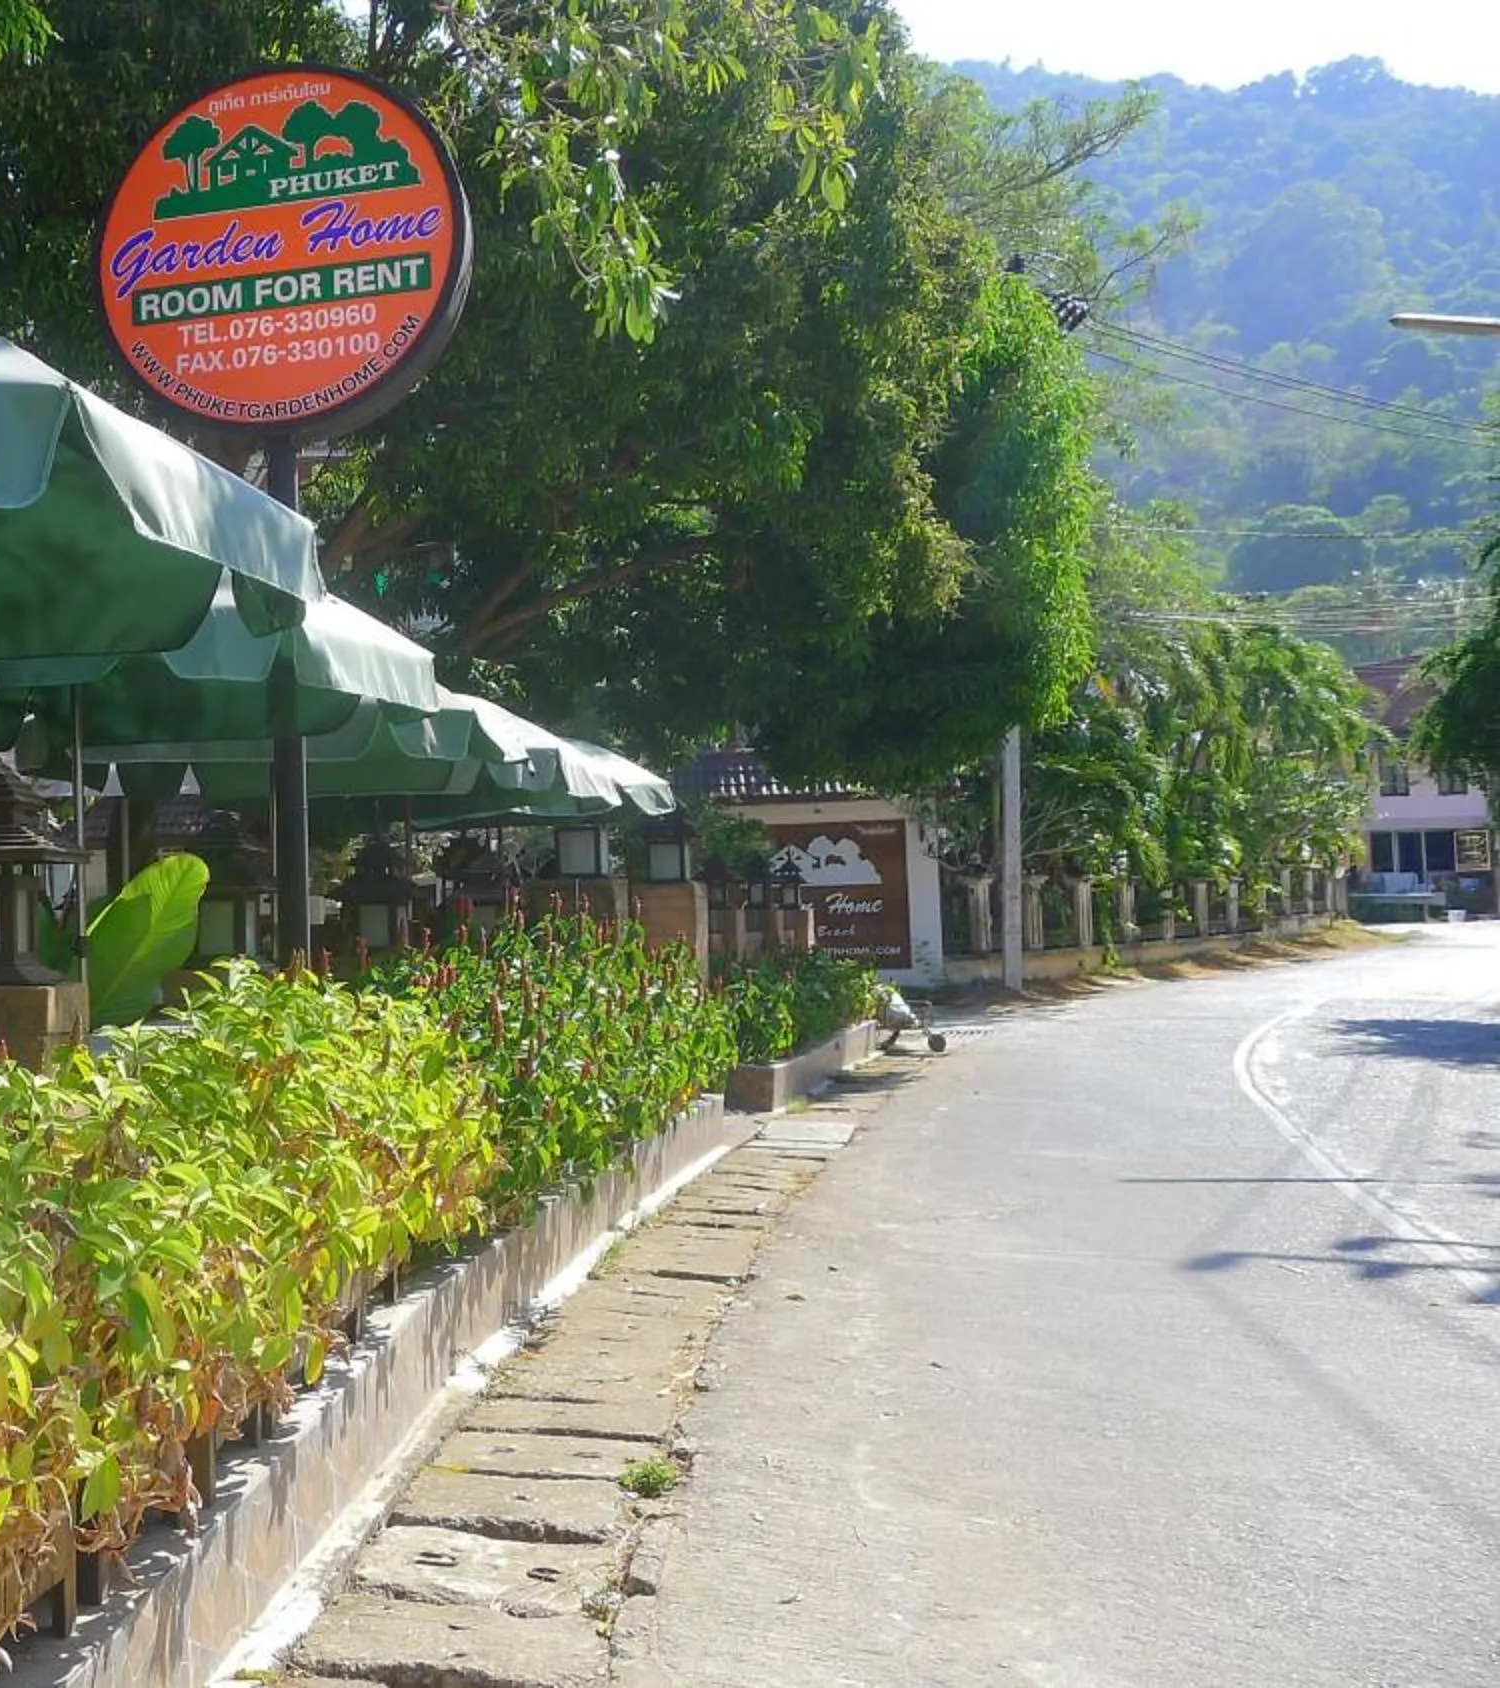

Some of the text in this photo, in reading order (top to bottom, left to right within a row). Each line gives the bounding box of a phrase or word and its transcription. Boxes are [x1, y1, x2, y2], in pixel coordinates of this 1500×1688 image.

[269, 161, 400, 198] PHUKET
[110, 200, 444, 301] Garden Home
[140, 258, 426, 321] ROOM FOR RENT
[177, 303, 377, 347] TEL.076-330960
[131, 314, 422, 420] WWW.PHUKETGARDENHOME.COM
[175, 331, 380, 375] FAX.076-330100
[826, 892, 884, 914] Home
